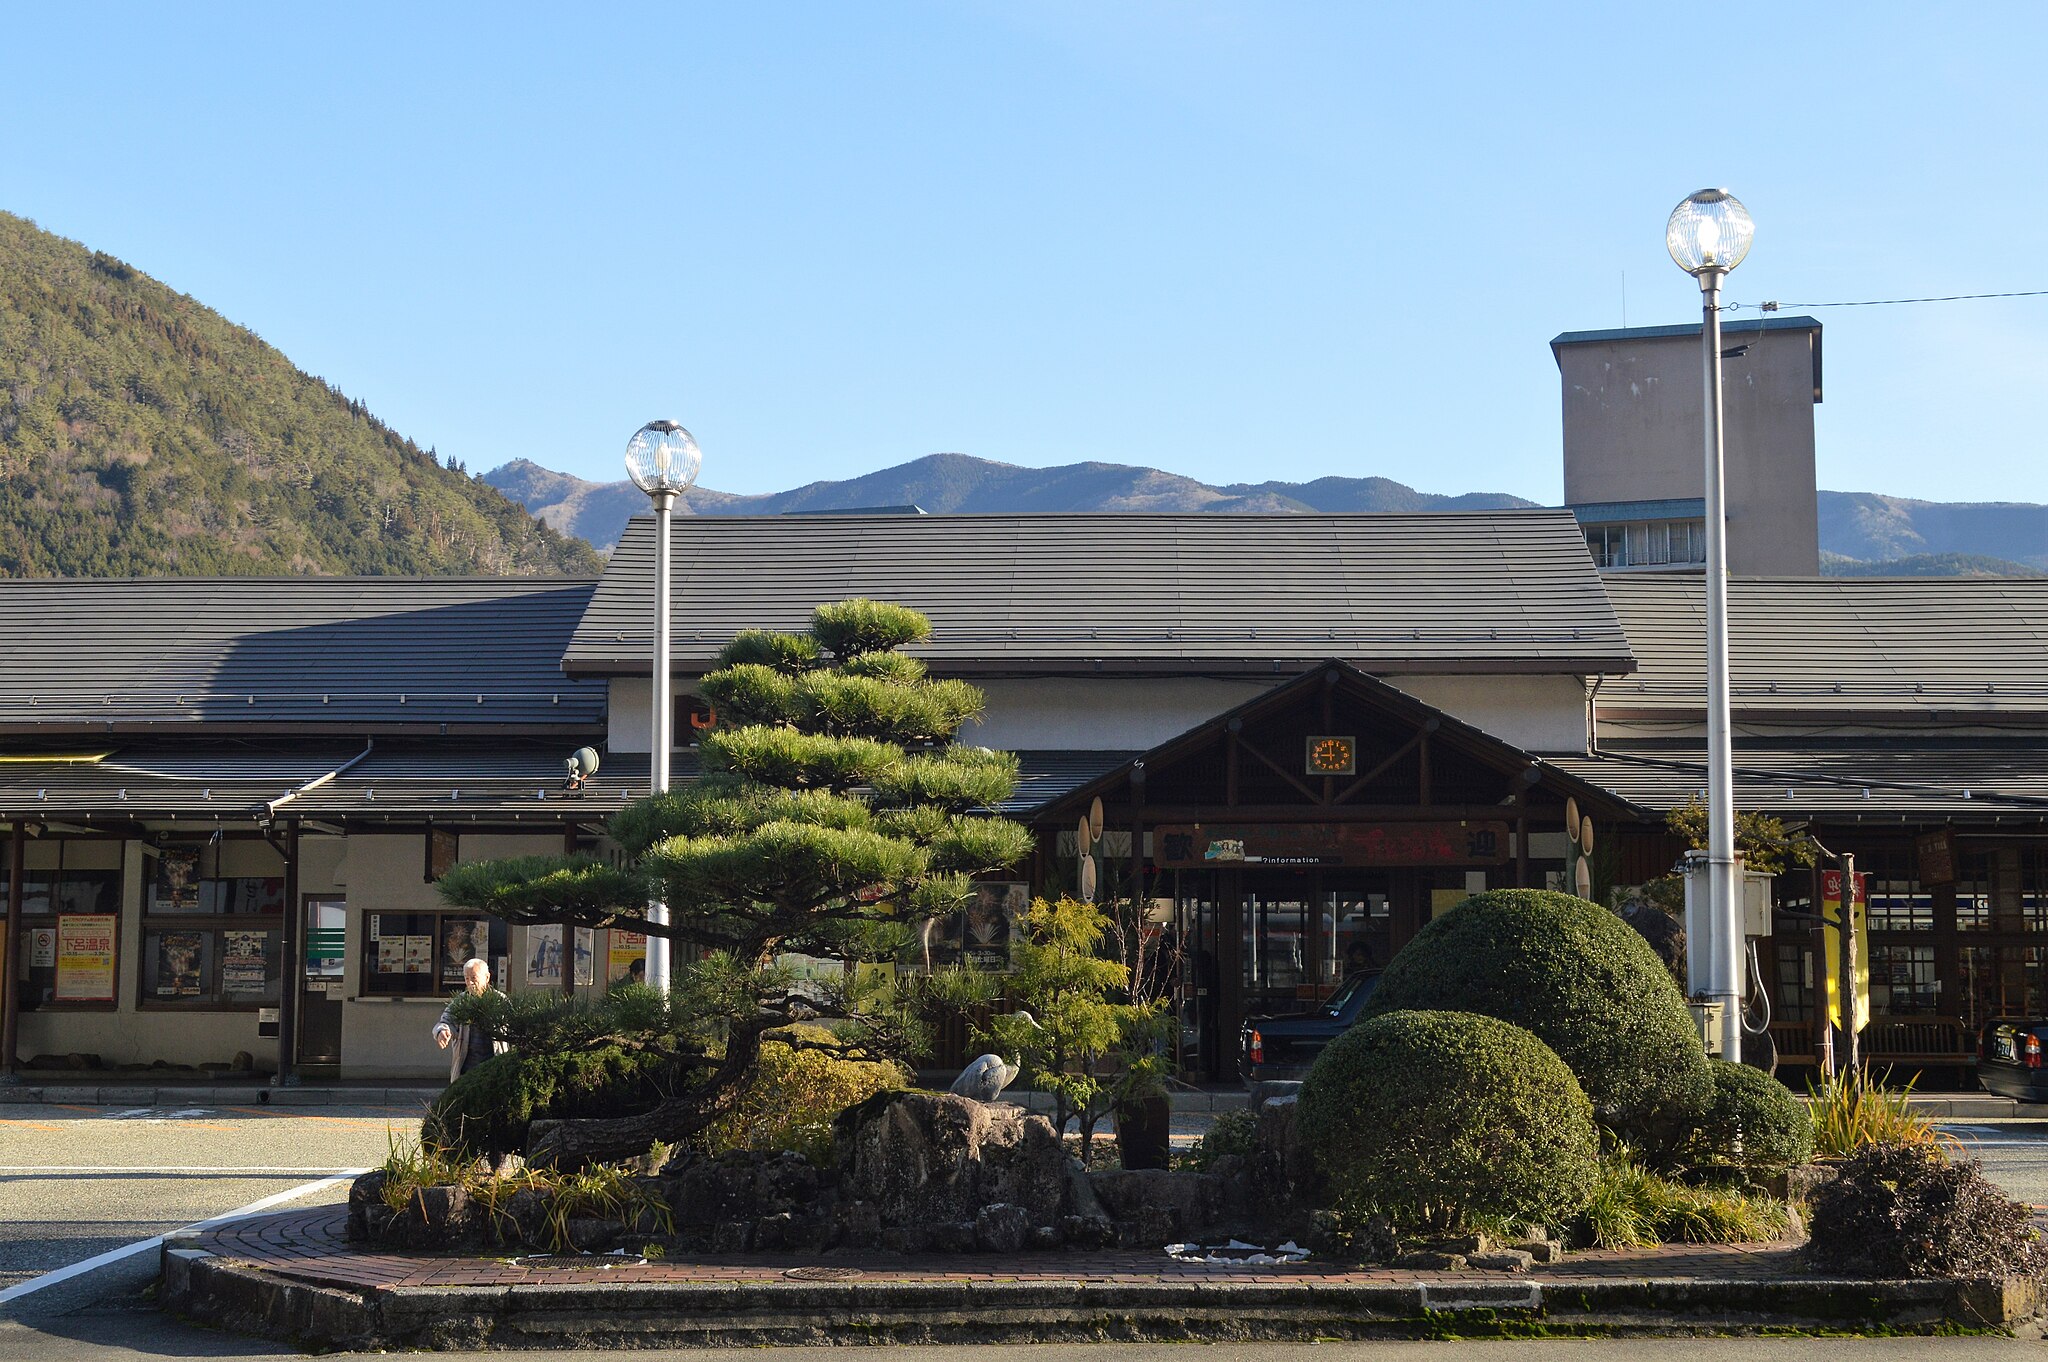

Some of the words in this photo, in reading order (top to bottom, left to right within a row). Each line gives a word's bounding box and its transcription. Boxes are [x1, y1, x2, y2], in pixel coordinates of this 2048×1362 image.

[1467, 830, 1496, 858] 迎
[62, 938, 111, 951] 下呂温泉
